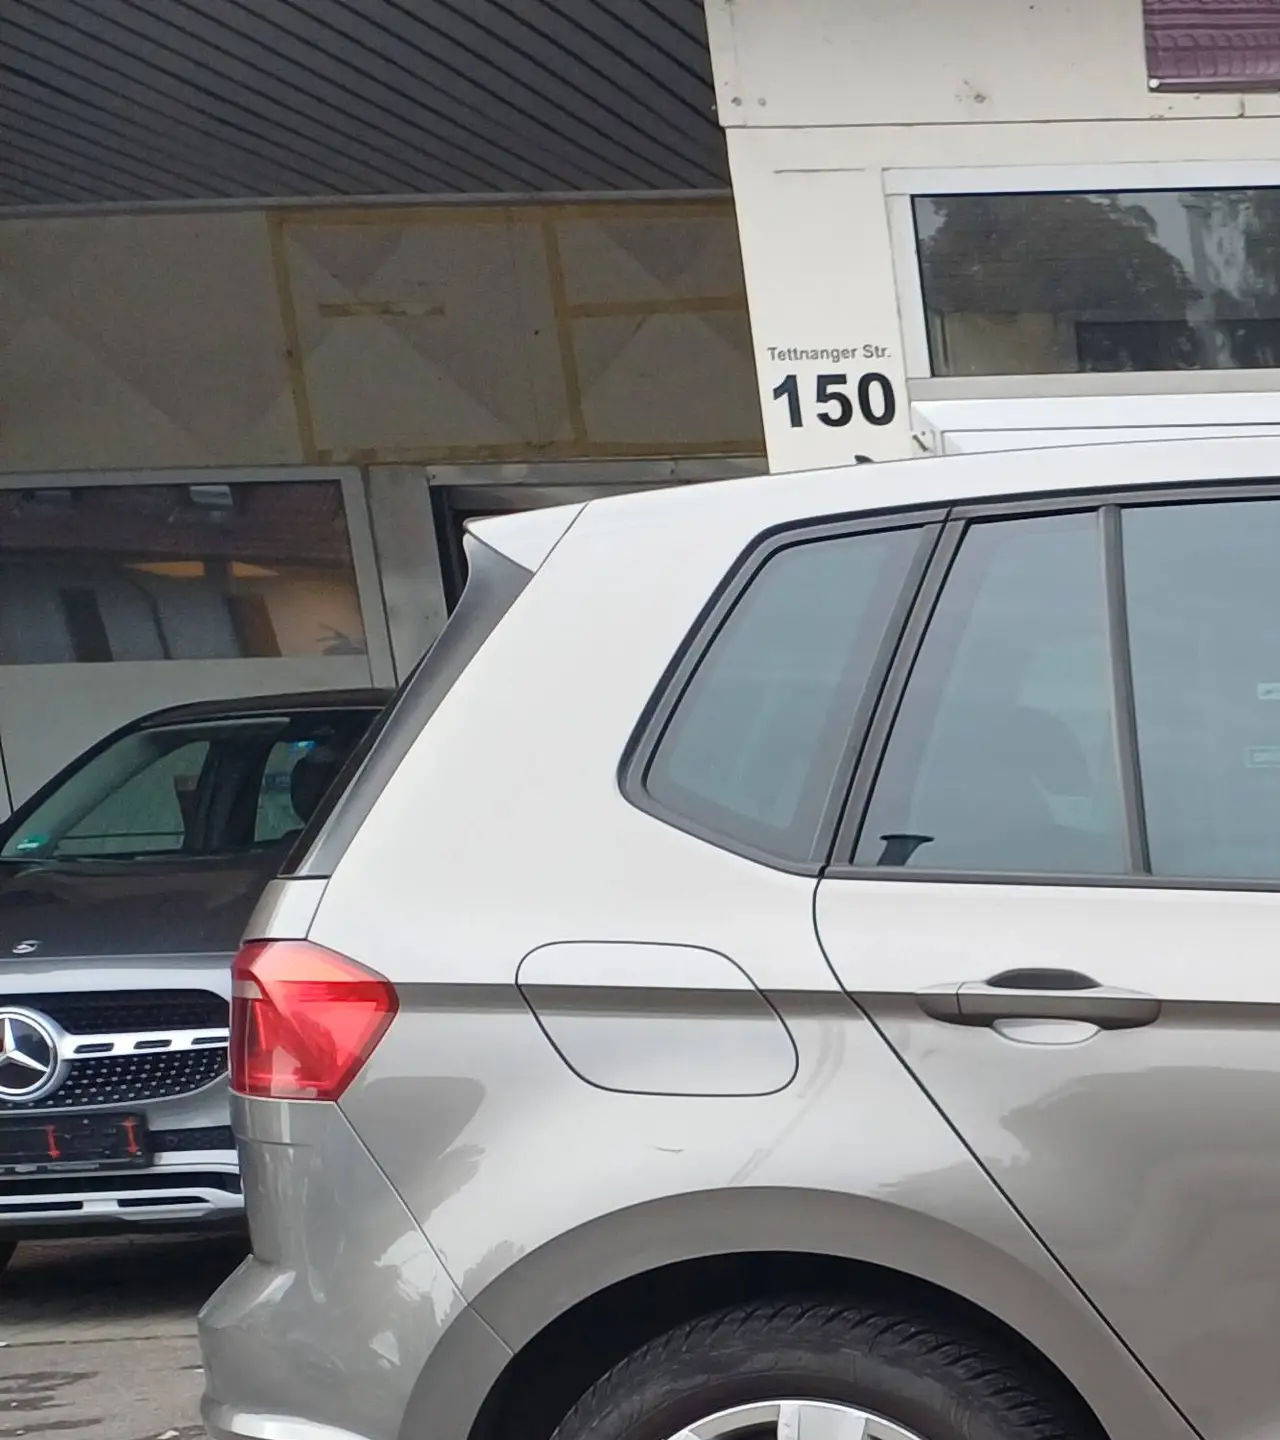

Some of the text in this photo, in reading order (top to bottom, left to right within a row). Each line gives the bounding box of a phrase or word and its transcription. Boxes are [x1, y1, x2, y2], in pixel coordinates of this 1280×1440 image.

[767, 344, 892, 363] Tettnanger Str.
[773, 372, 896, 427] 150
